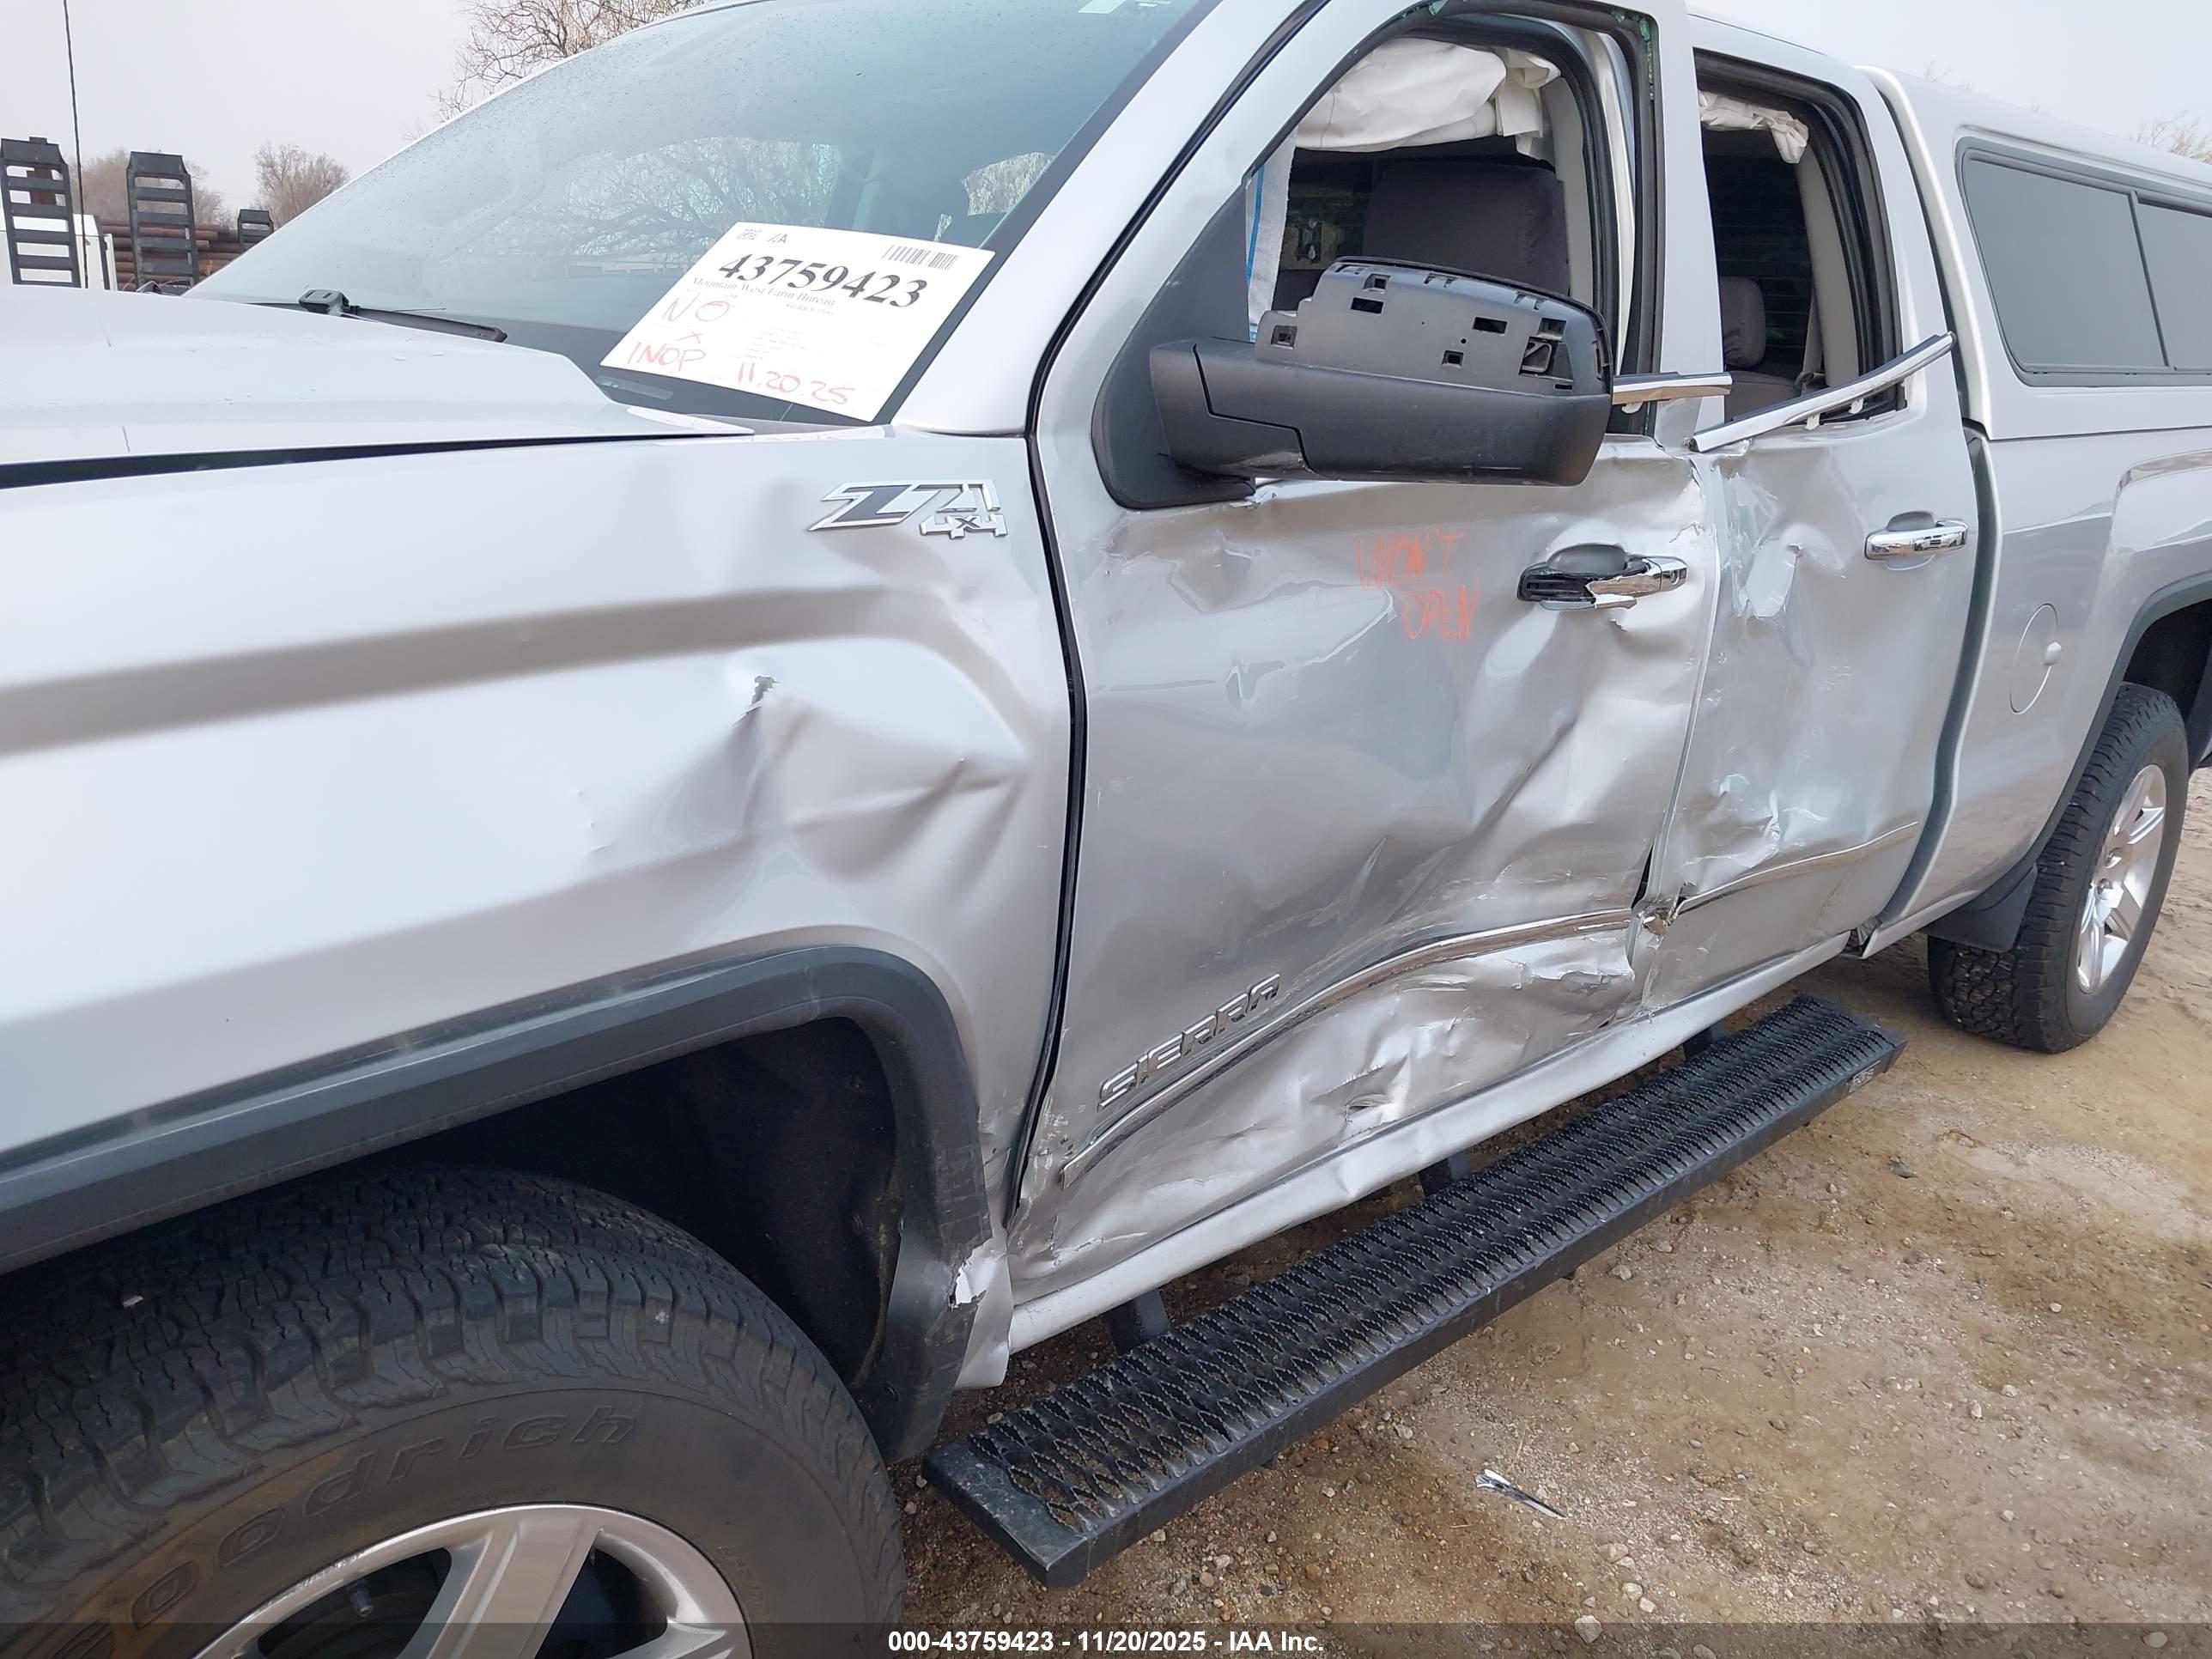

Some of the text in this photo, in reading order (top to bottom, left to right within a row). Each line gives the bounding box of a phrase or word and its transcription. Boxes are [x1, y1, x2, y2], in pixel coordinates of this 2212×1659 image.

[719, 253, 927, 308] 43759423
[741, 283, 767, 296] West
[767, 288, 795, 301] Farm
[796, 292, 837, 307] Bureau
[661, 292, 730, 323] NO
[626, 341, 707, 372] INOP
[806, 479, 1001, 532] Z71
[1401, 576, 1482, 641] OPEN
[1097, 974, 1280, 1113] SIERRA
